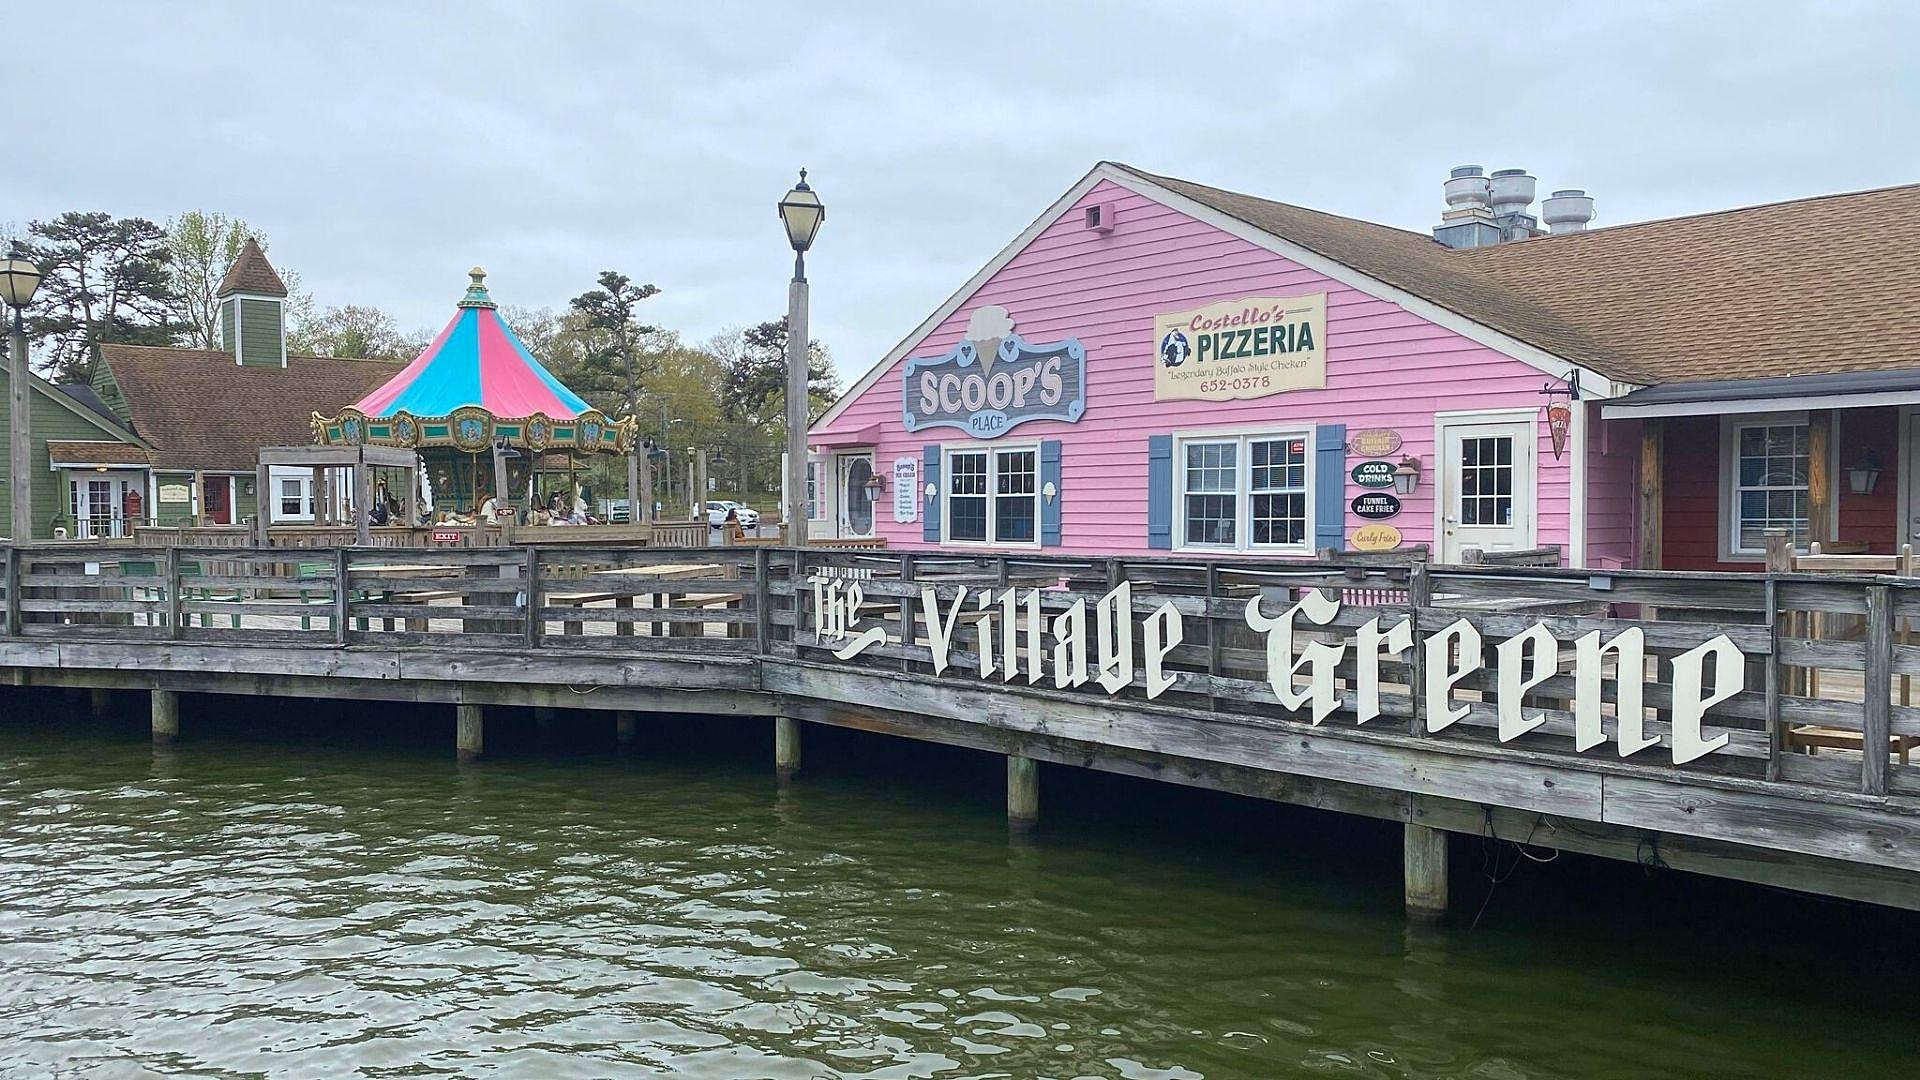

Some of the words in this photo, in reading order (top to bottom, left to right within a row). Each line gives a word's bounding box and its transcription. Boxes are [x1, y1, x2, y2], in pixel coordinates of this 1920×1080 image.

[1189, 305, 1285, 332] Costello's
[1197, 321, 1315, 362] PIZZERIA
[1215, 364, 1246, 377] Buffalo
[1247, 362, 1269, 374] Style
[920, 356, 1063, 415] SCOOP'S
[1200, 375, 1271, 392] 652-0378
[972, 415, 1004, 431] PLACE
[1363, 464, 1388, 473] COLD
[1358, 474, 1393, 482] DRINKS
[1363, 497, 1388, 505] FUNNEL
[1357, 505, 1375, 513] CAKE
[1375, 505, 1394, 513] FRIES
[1357, 531, 1378, 545] Curly
[1378, 531, 1396, 543] Fries
[807, 575, 887, 660] The
[921, 580, 1183, 700] Village
[1244, 587, 1745, 765] Greene
